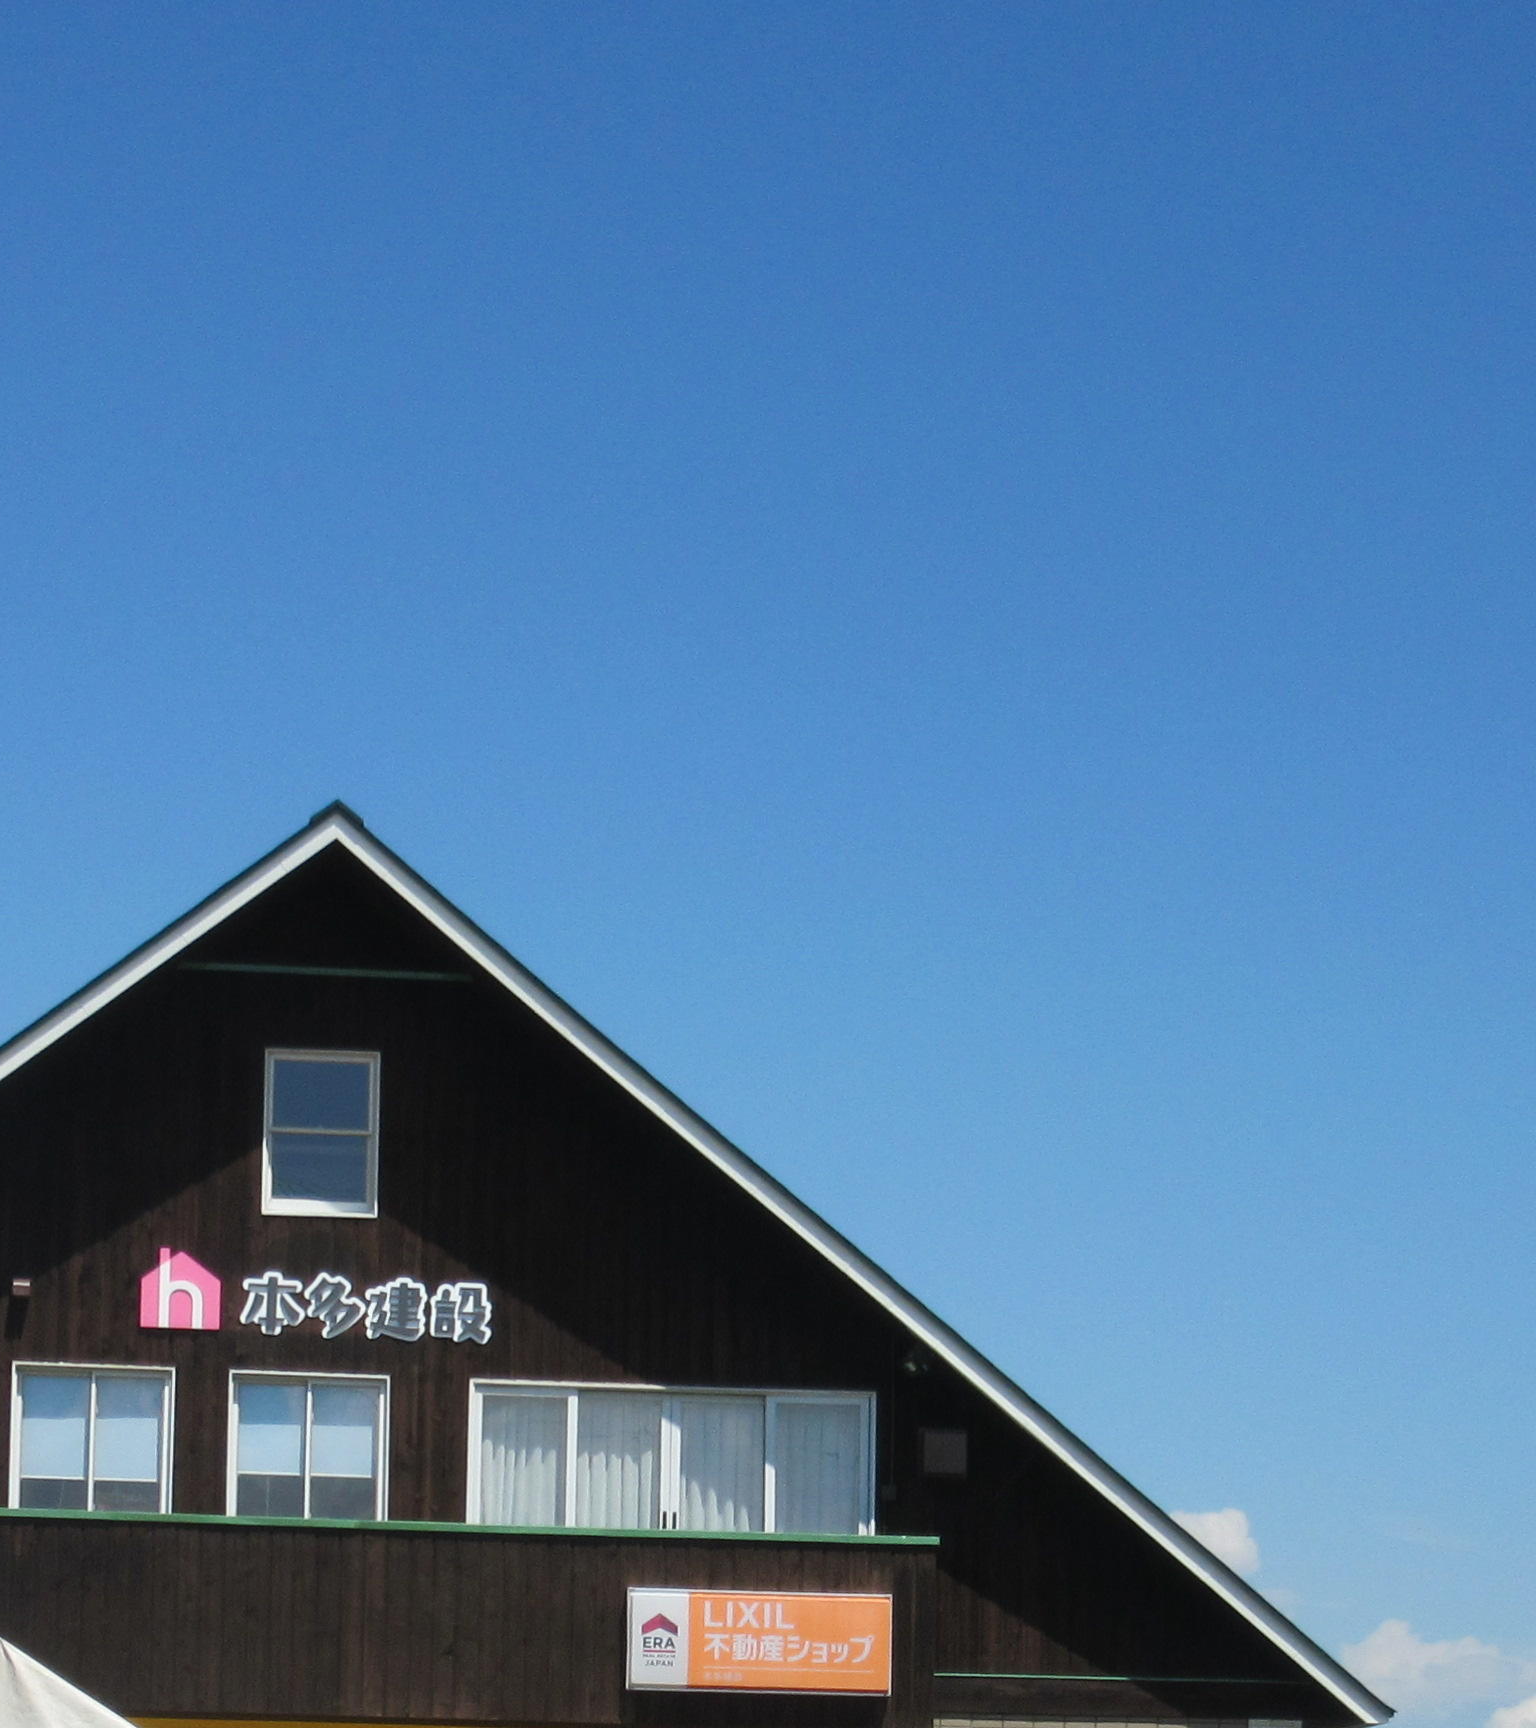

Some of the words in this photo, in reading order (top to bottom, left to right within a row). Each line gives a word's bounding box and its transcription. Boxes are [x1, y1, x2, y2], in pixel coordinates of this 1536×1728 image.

[240, 1271, 493, 1345] 本多建設
[703, 1600, 795, 1629] LIXIL
[642, 1636, 676, 1649] ERA
[703, 1632, 876, 1664] 不動産ショップ
[645, 1659, 674, 1667] JAPAN
